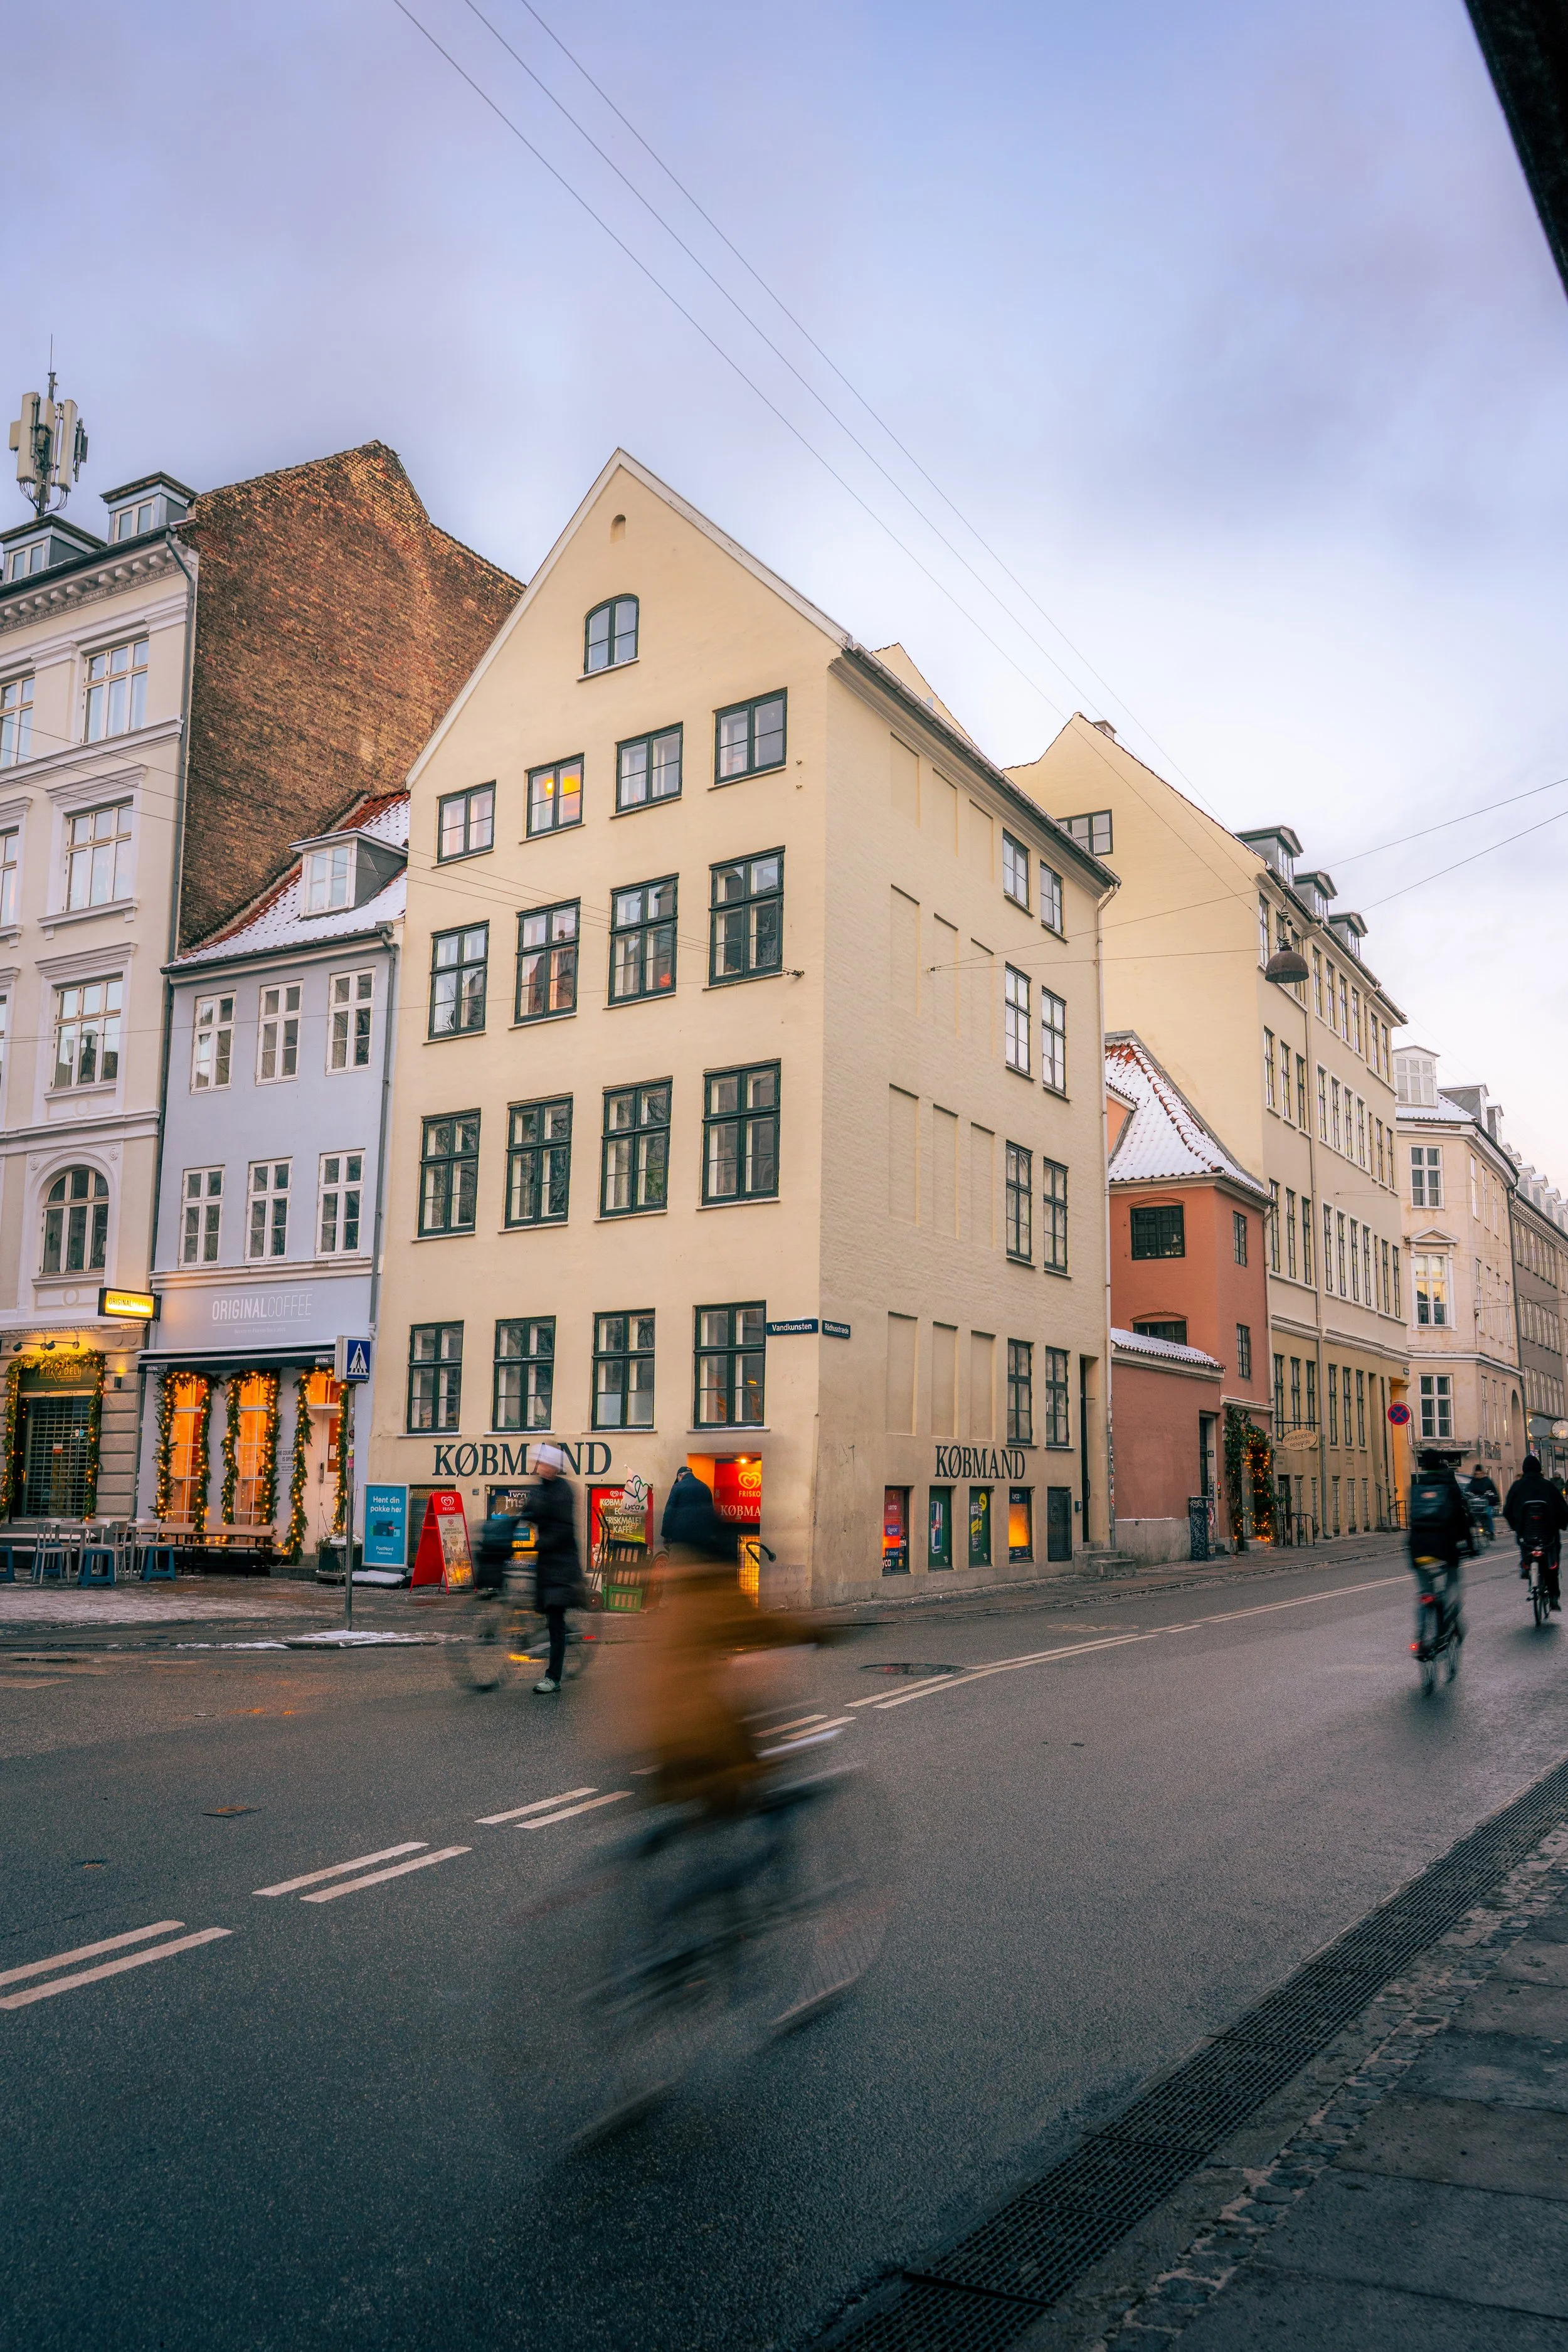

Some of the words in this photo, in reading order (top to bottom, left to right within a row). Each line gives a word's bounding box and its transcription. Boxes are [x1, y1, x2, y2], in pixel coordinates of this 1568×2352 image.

[771, 1323, 812, 1331] Vandkunsten
[824, 1323, 849, 1335] Rådhusstræde
[1285, 1433, 1313, 1442] SKRÆDDERI
[935, 1445, 1025, 1479] KØBMAND
[625, 1503, 640, 1511] Lyca
